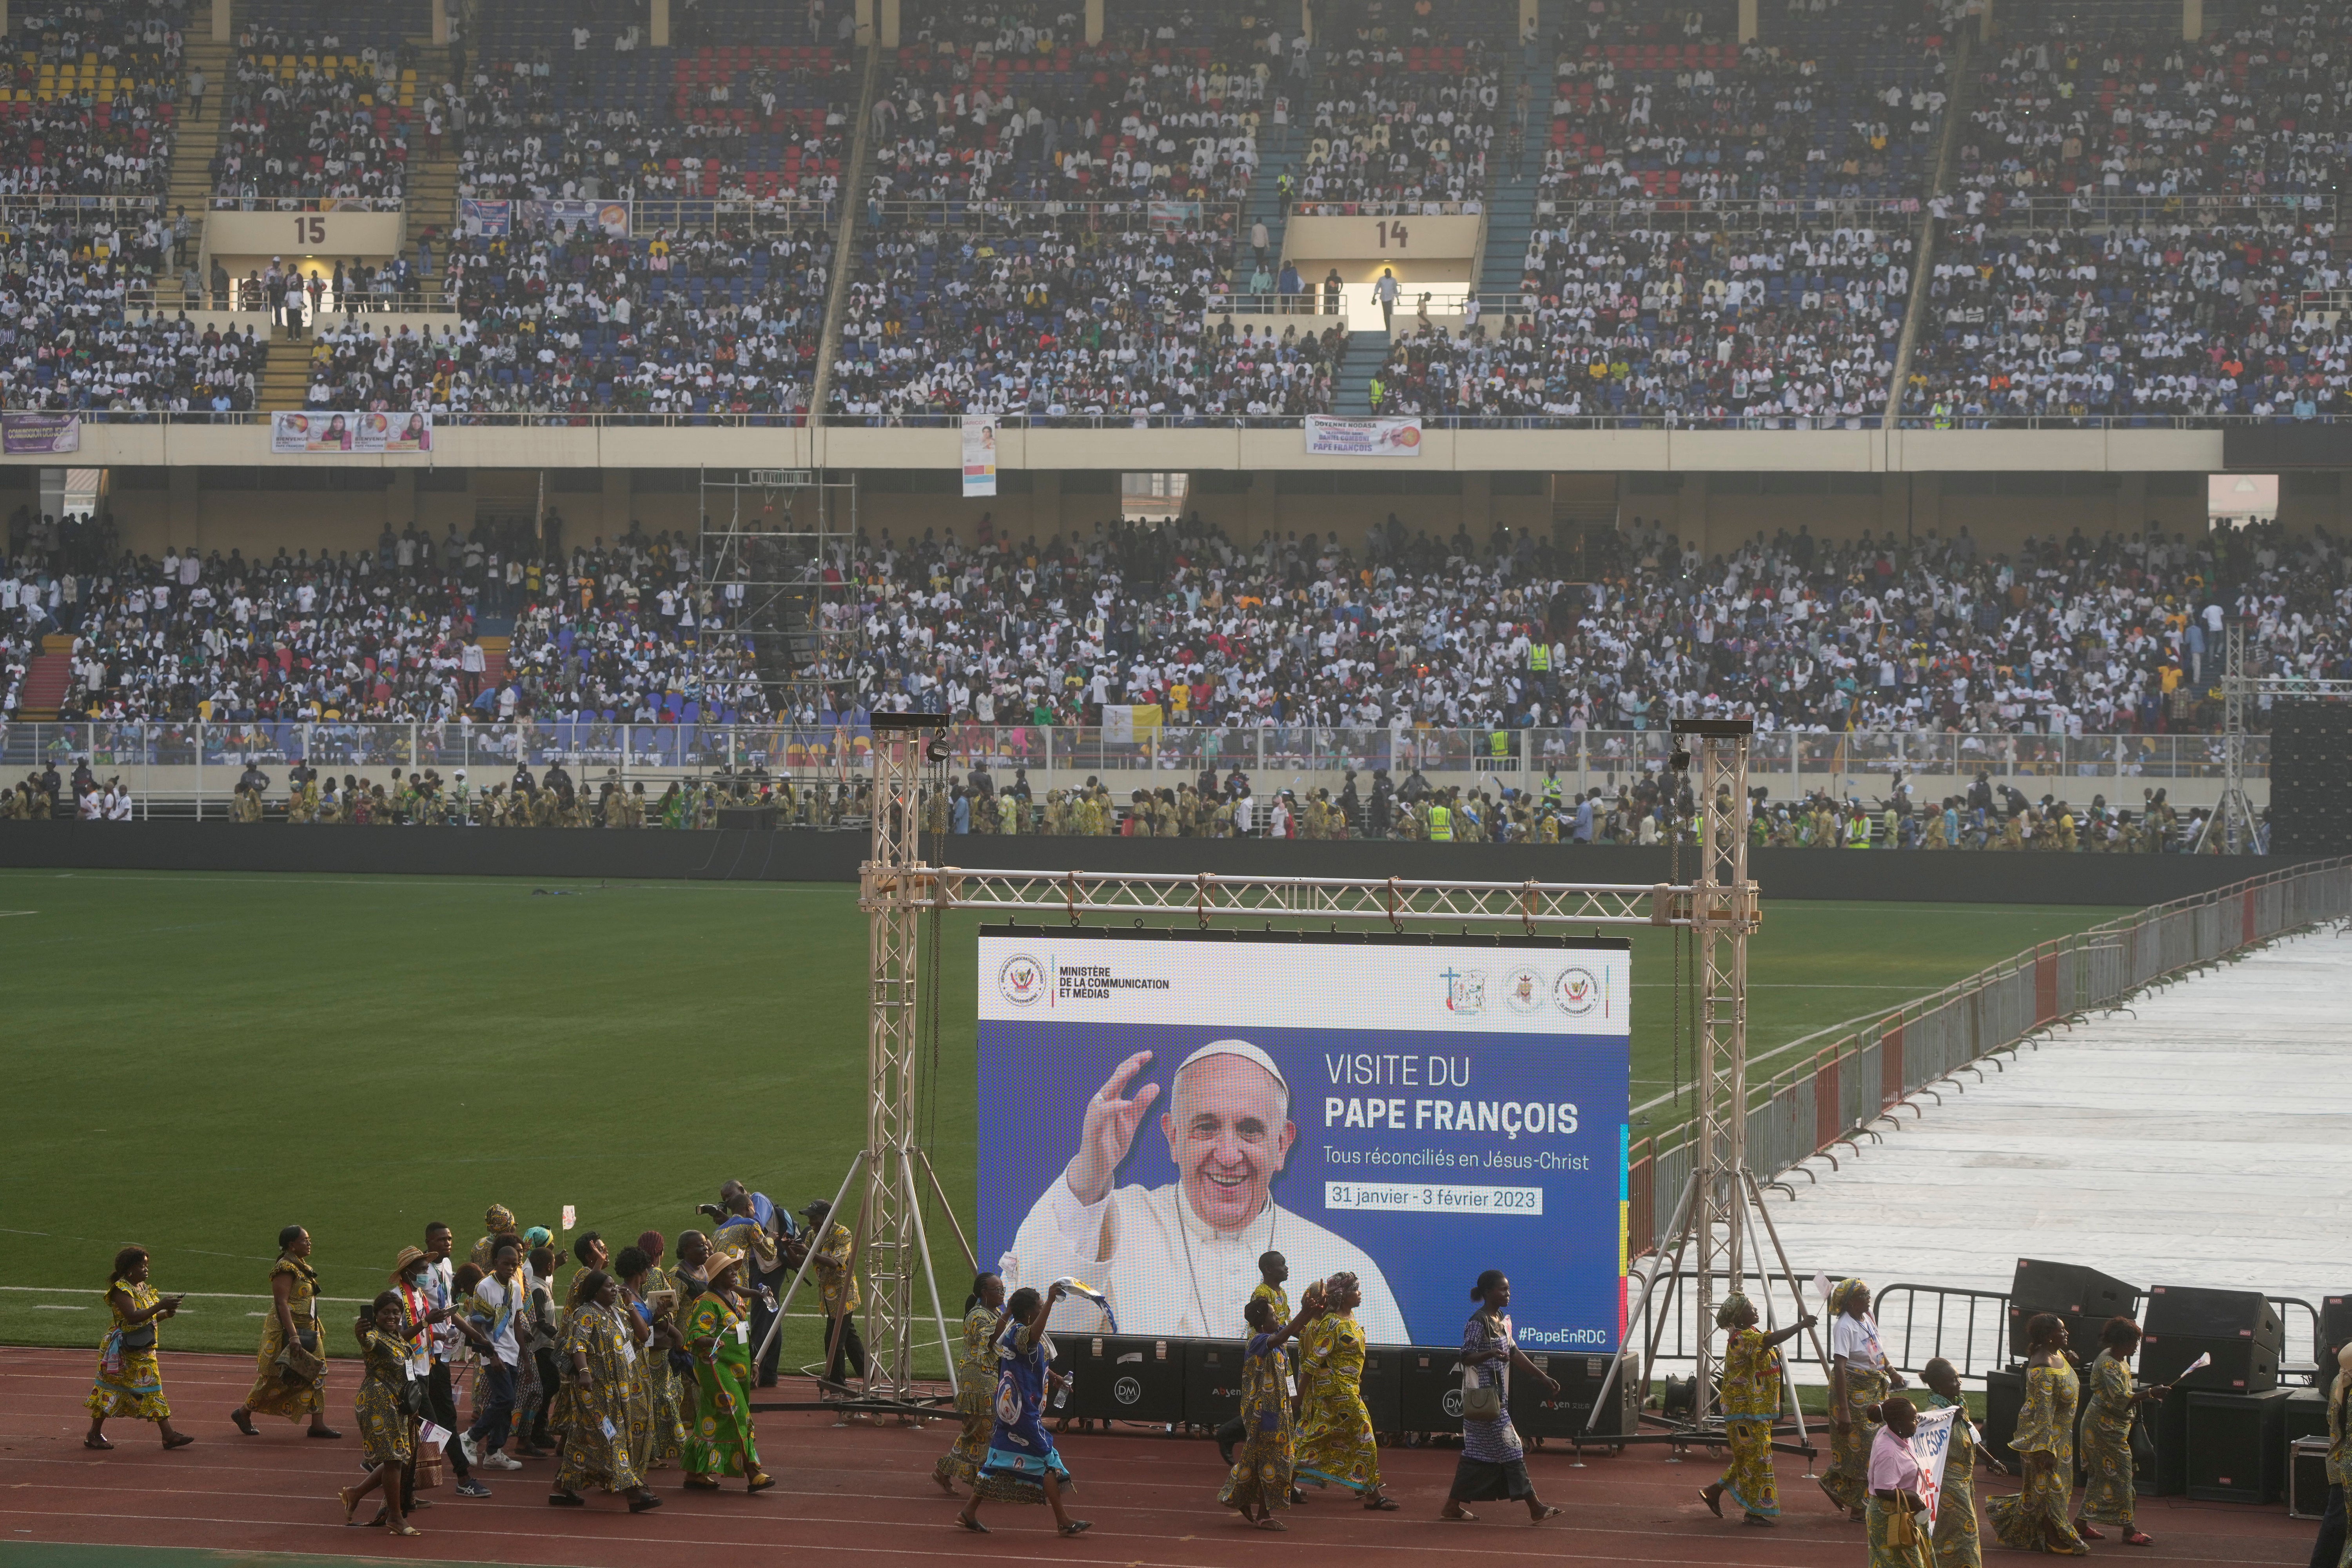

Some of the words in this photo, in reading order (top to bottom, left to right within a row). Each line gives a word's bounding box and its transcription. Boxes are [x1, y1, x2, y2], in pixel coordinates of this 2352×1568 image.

[294, 217, 325, 244] 15
[1376, 221, 1408, 248] 14
[1060, 965, 1110, 976] MINISTÈRE
[1060, 977, 1072, 987] DE
[1074, 978, 1085, 987] LA
[1088, 978, 1169, 989] COMMUNICATION
[1060, 988, 1071, 998] ET
[1073, 987, 1110, 998] MÉDIAS
[1325, 1054, 1418, 1085] VISITE
[1429, 1056, 1469, 1087] DU
[1325, 1098, 1405, 1129] PAPE
[1416, 1100, 1578, 1140] FRANÇOIS
[1323, 1146, 1361, 1163] Tous
[1365, 1147, 1454, 1167] réconciliés
[1459, 1155, 1478, 1167] en
[1483, 1150, 1589, 1170] Jésus-Christ
[1332, 1186, 1352, 1202] 31
[1356, 1187, 1408, 1206] janvier
[1423, 1189, 1433, 1204] 3
[1437, 1190, 1488, 1206] février
[1494, 1191, 1535, 1208] 2023
[404, 1303, 414, 1327] CONG
[1519, 1327, 1606, 1345] #PapeEnRDC
[1119, 1385, 1136, 1396] DM
[1212, 1387, 1241, 1397] Absen
[1540, 1400, 1570, 1410] Absen
[1913, 1433, 1926, 1458] AINT
